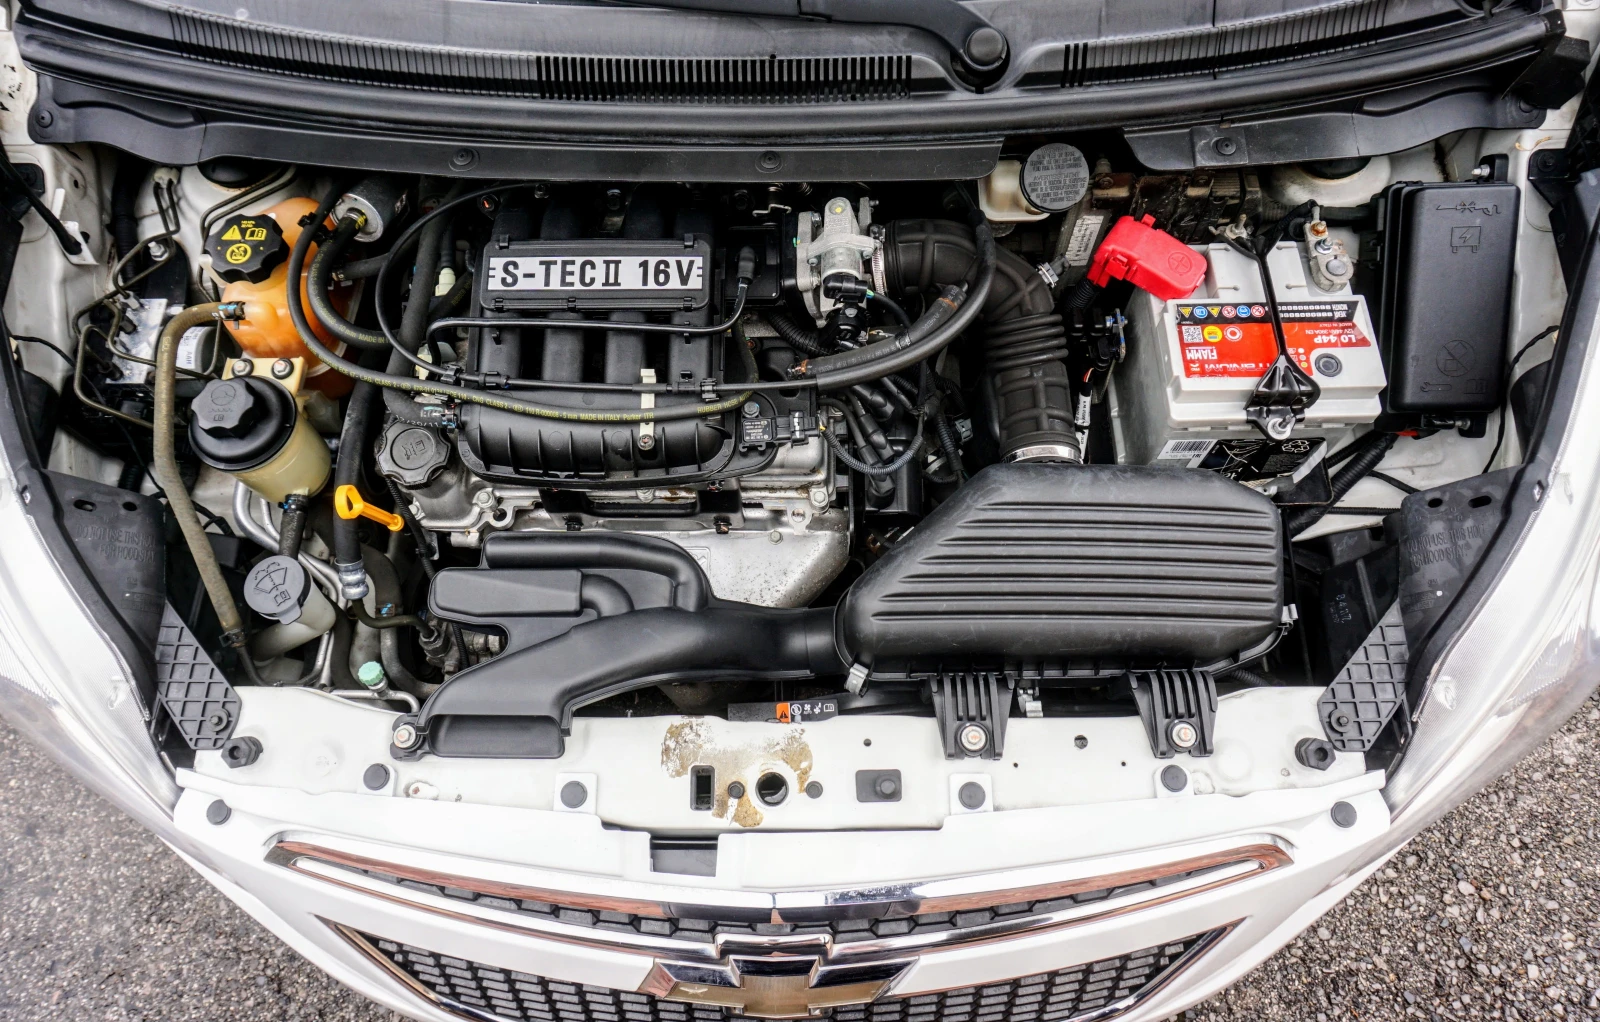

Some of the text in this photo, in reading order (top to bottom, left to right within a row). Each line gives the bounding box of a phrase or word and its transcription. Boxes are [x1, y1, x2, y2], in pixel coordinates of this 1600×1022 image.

[639, 260, 695, 287] 16V
[358, 333, 377, 343] MADE
[1313, 335, 1337, 343] 44P
[1185, 349, 1217, 360] FIAMM
[486, 398, 504, 409] CLASS
[580, 413, 597, 421] MADE
[597, 413, 604, 421] IN
[605, 413, 620, 421] ITALY
[623, 413, 641, 421] Parker
[697, 404, 722, 414] RUBBER
[724, 399, 739, 409] HOSE
